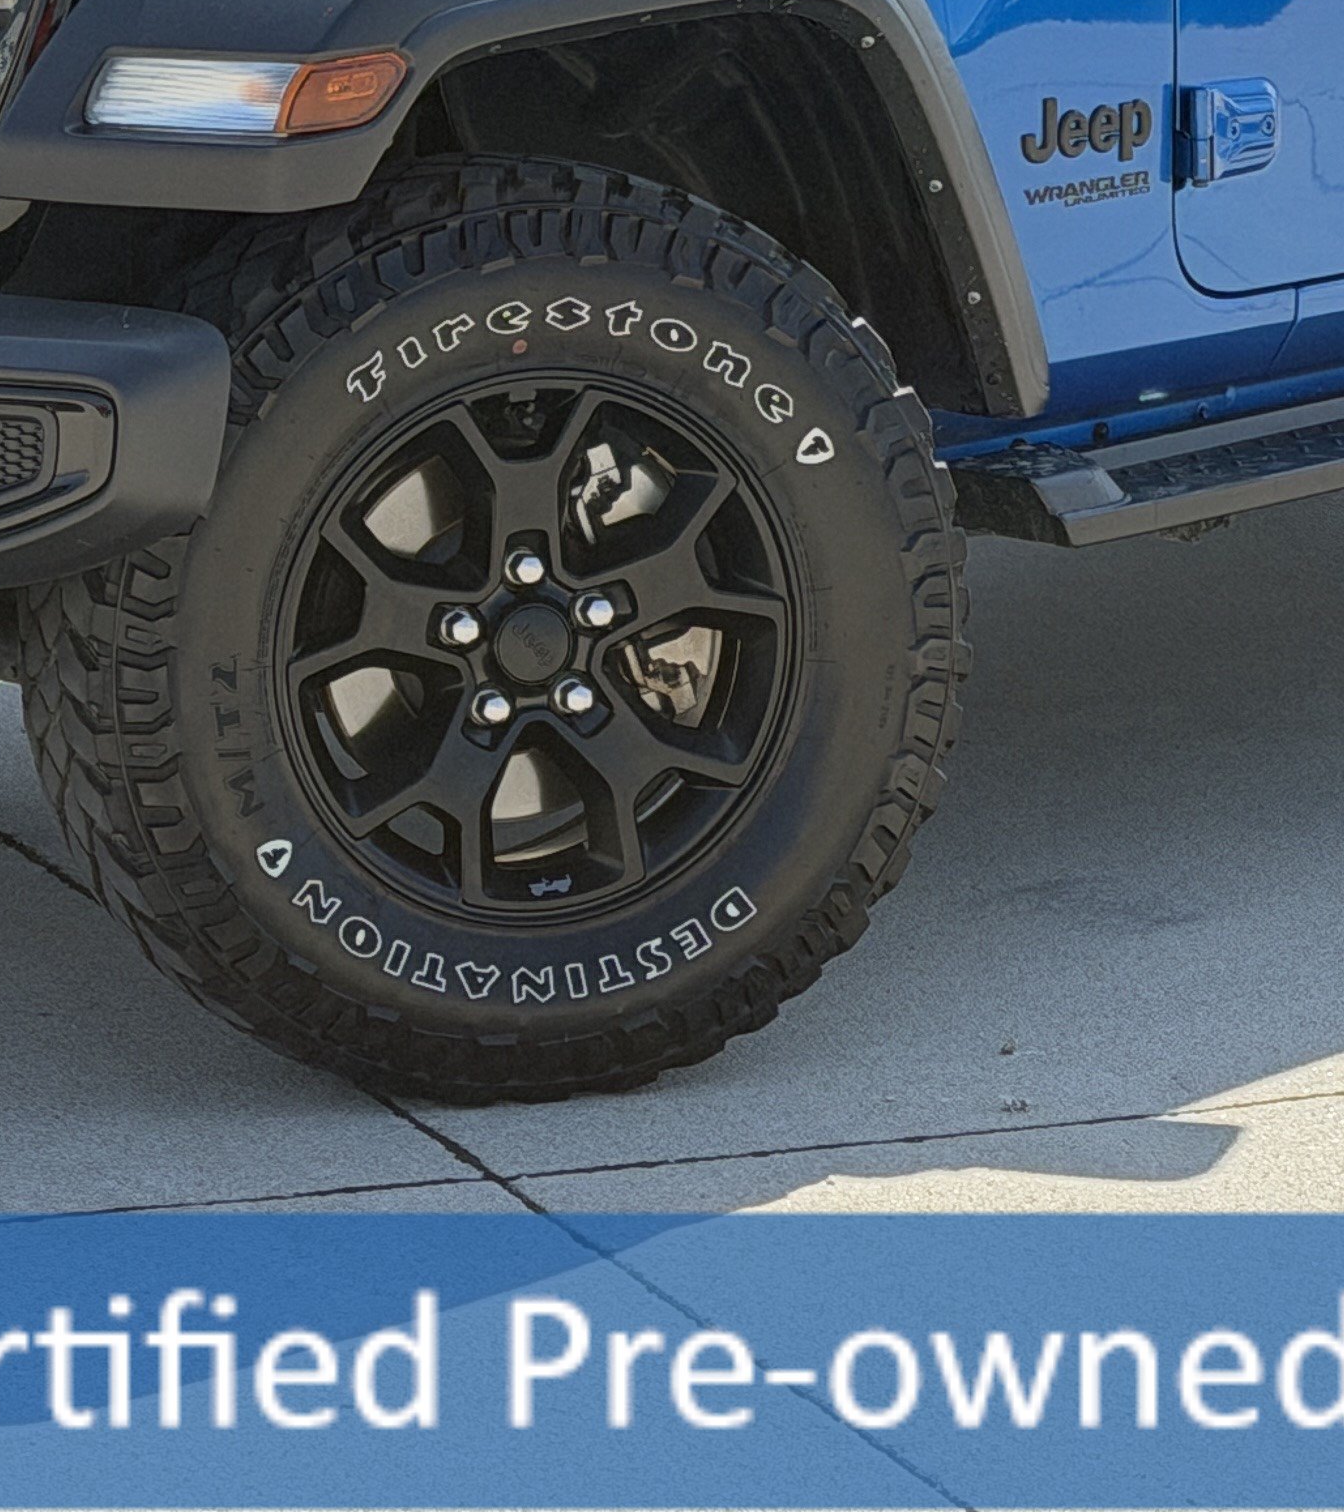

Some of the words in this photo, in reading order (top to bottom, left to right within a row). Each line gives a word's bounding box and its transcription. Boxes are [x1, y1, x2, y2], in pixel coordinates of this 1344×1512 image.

[1020, 96, 1152, 164] Jeep
[1023, 170, 1150, 206] WRANGLER
[1063, 185, 1151, 208] UNLIMITED
[512, 622, 556, 668] Jeep
[292, 879, 759, 1004] DESTINATION
